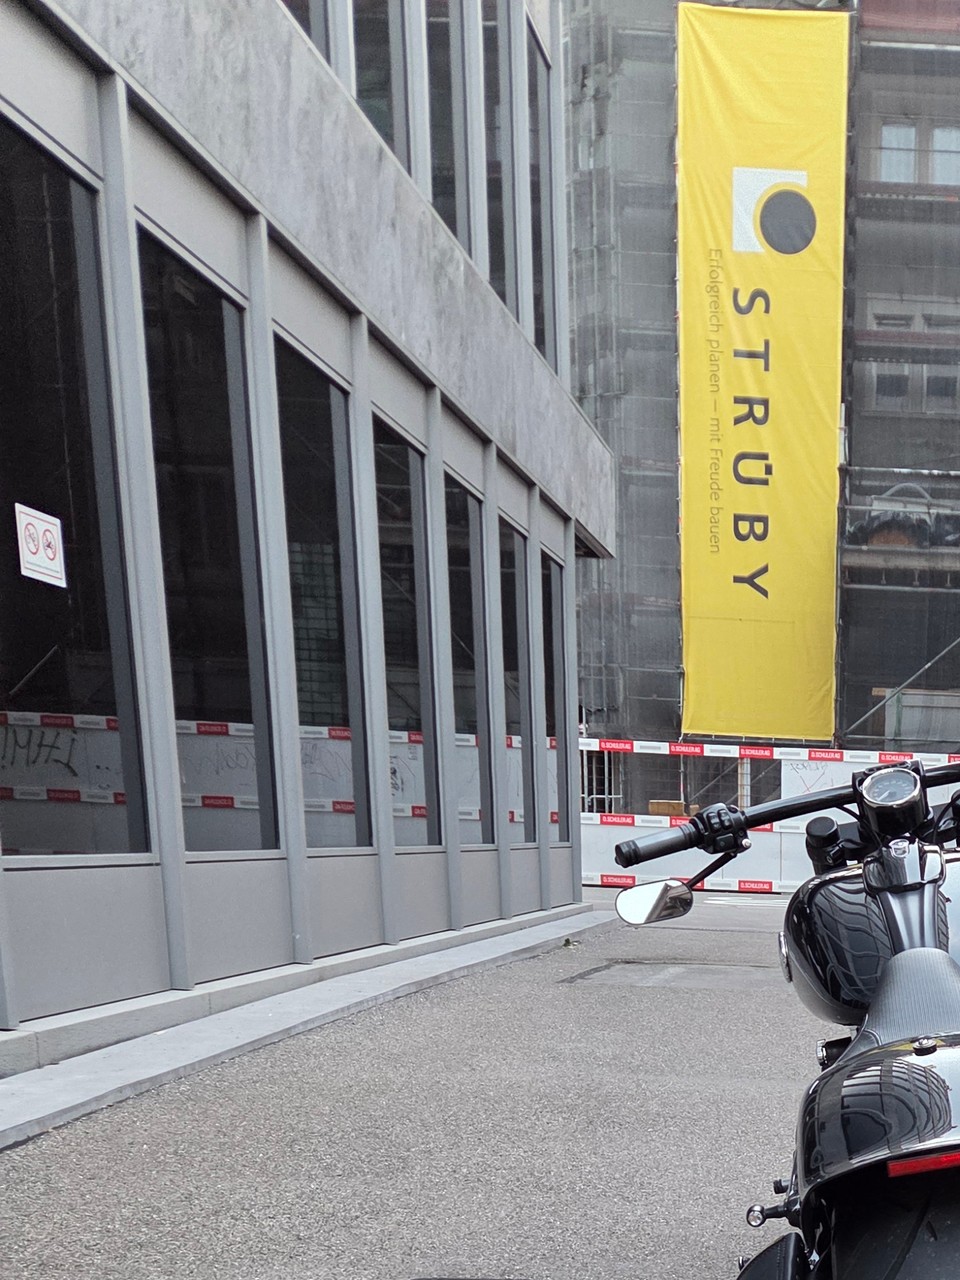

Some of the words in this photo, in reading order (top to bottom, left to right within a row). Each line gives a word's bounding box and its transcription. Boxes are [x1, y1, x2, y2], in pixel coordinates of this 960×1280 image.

[705, 248, 724, 333] Erfolgreich
[706, 338, 724, 393] planen
[709, 417, 724, 443] mit
[732, 287, 773, 600] STRÜBY
[709, 448, 724, 501] Freude
[709, 507, 724, 554] bauen
